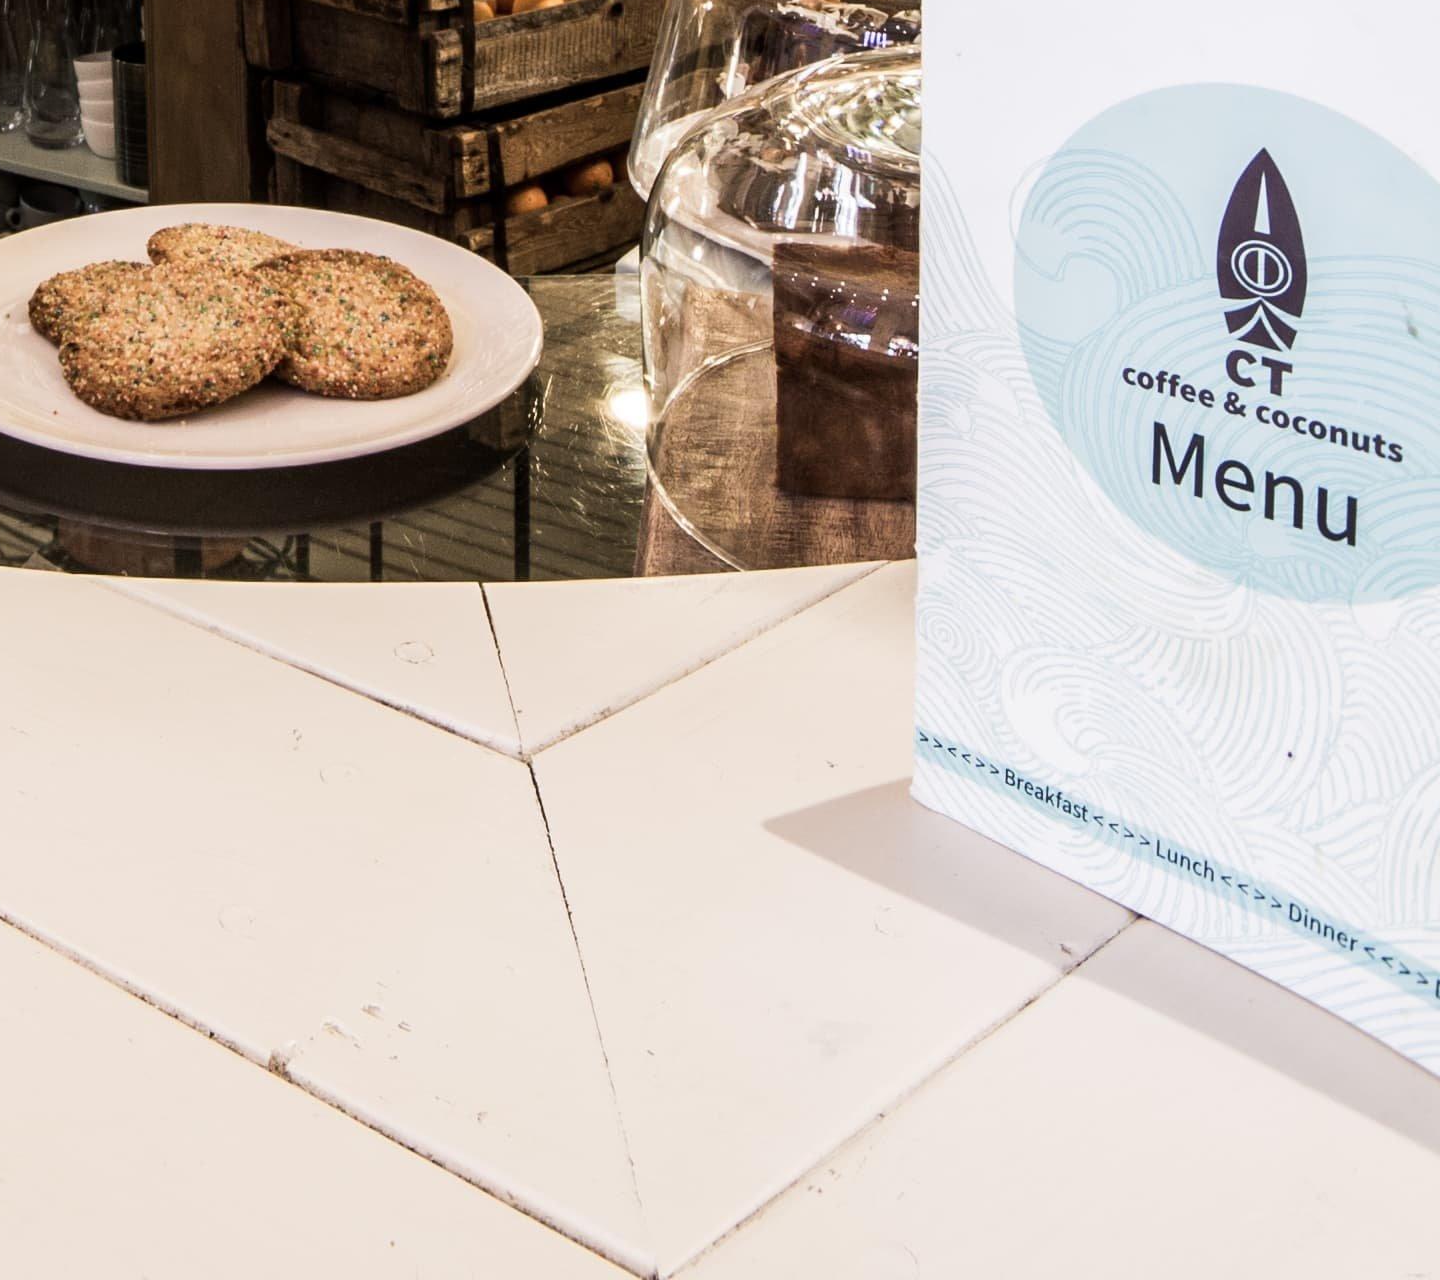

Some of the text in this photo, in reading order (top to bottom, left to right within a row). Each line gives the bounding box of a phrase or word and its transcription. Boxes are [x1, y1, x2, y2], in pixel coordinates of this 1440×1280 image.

[1122, 366, 1404, 463] coffee & coconuts
[1225, 349, 1294, 397] CT
[1151, 420, 1358, 547] Menu
[1003, 767, 1090, 823] Breakfast
[1155, 839, 1216, 883] Lunch
[1287, 902, 1360, 953] Dinner
